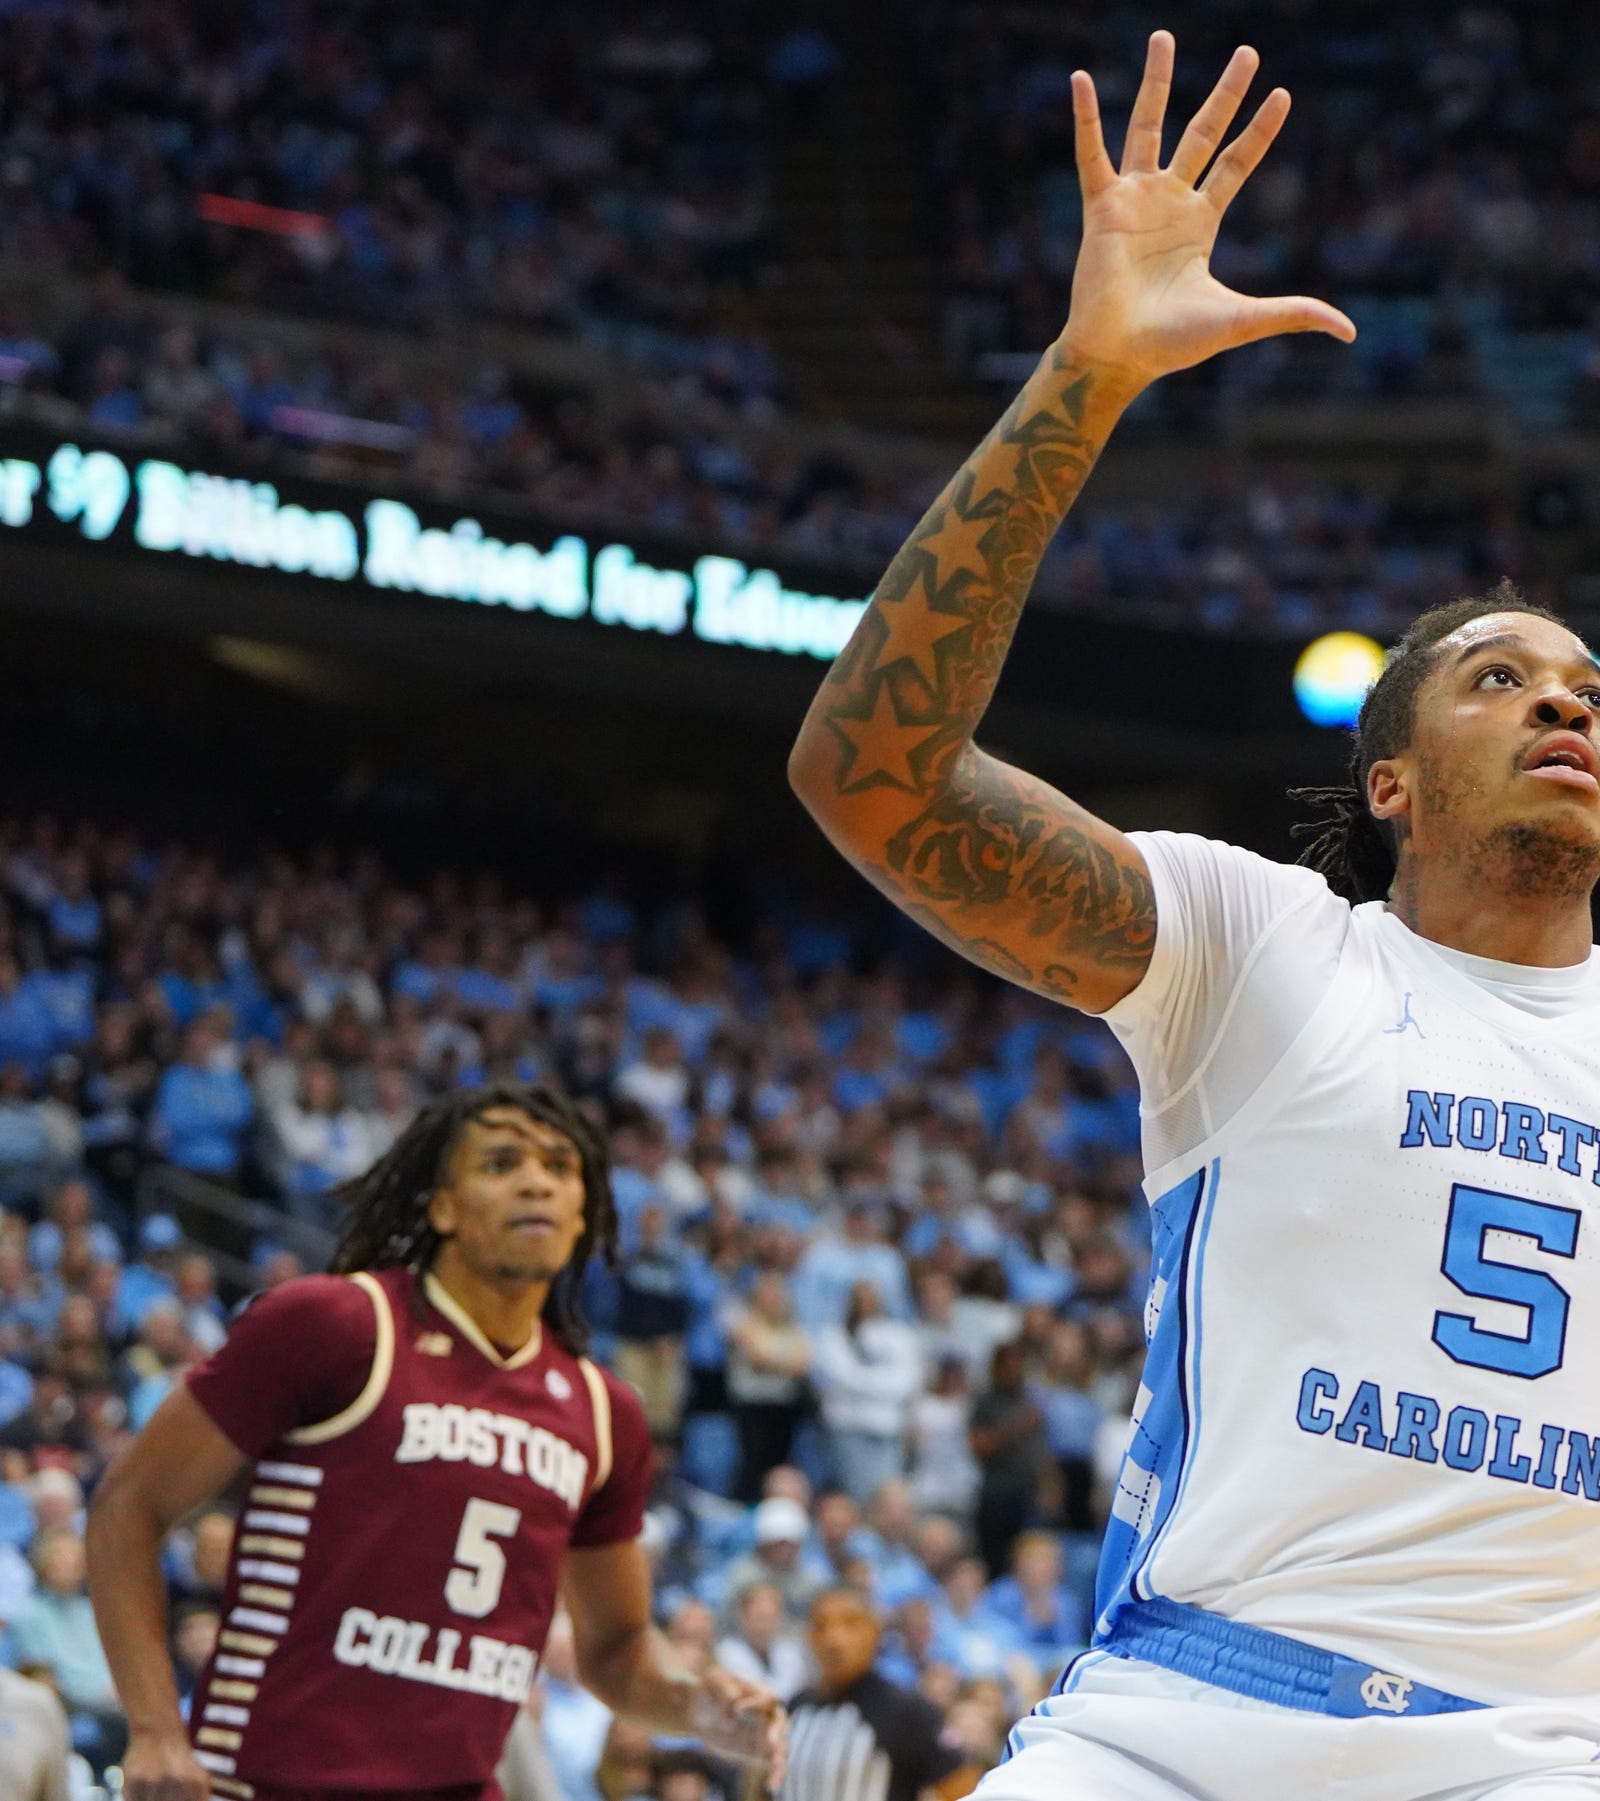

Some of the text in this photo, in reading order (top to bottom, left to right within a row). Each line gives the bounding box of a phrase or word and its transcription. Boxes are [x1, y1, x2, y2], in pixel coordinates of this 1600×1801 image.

[47, 443, 131, 540] $9
[134, 459, 360, 581] Billion
[363, 498, 589, 619] Raised
[591, 543, 694, 636] for
[1431, 1182, 1582, 1380] 5
[396, 1402, 589, 1511] BOSTON
[444, 1496, 522, 1618] 5
